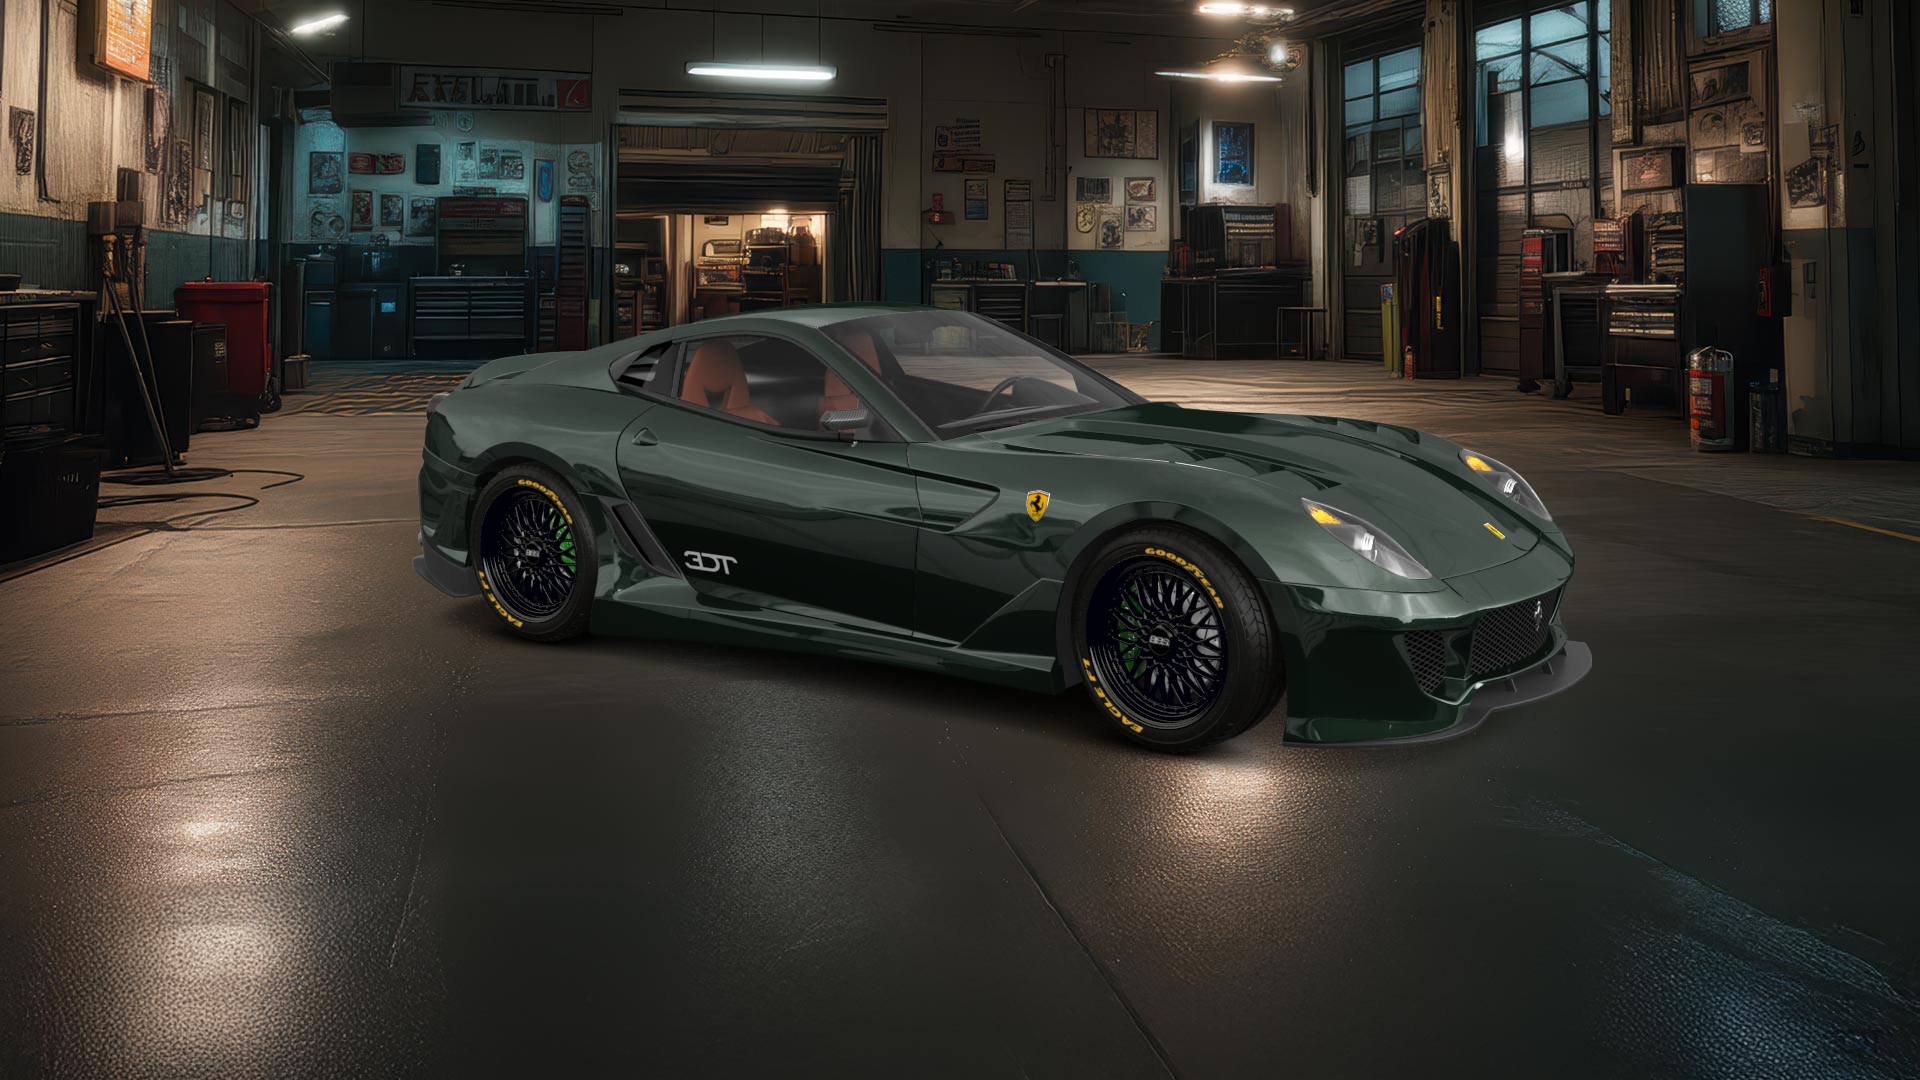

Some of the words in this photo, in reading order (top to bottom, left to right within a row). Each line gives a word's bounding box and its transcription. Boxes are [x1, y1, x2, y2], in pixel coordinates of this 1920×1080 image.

[518, 479, 573, 524] GOODYEAR
[684, 550, 738, 576] 3DT
[1144, 547, 1224, 609] GOODYEAR
[487, 593, 523, 628] EAGLE
[1149, 634, 1171, 647] BBS
[1094, 687, 1144, 733] EAGLE
